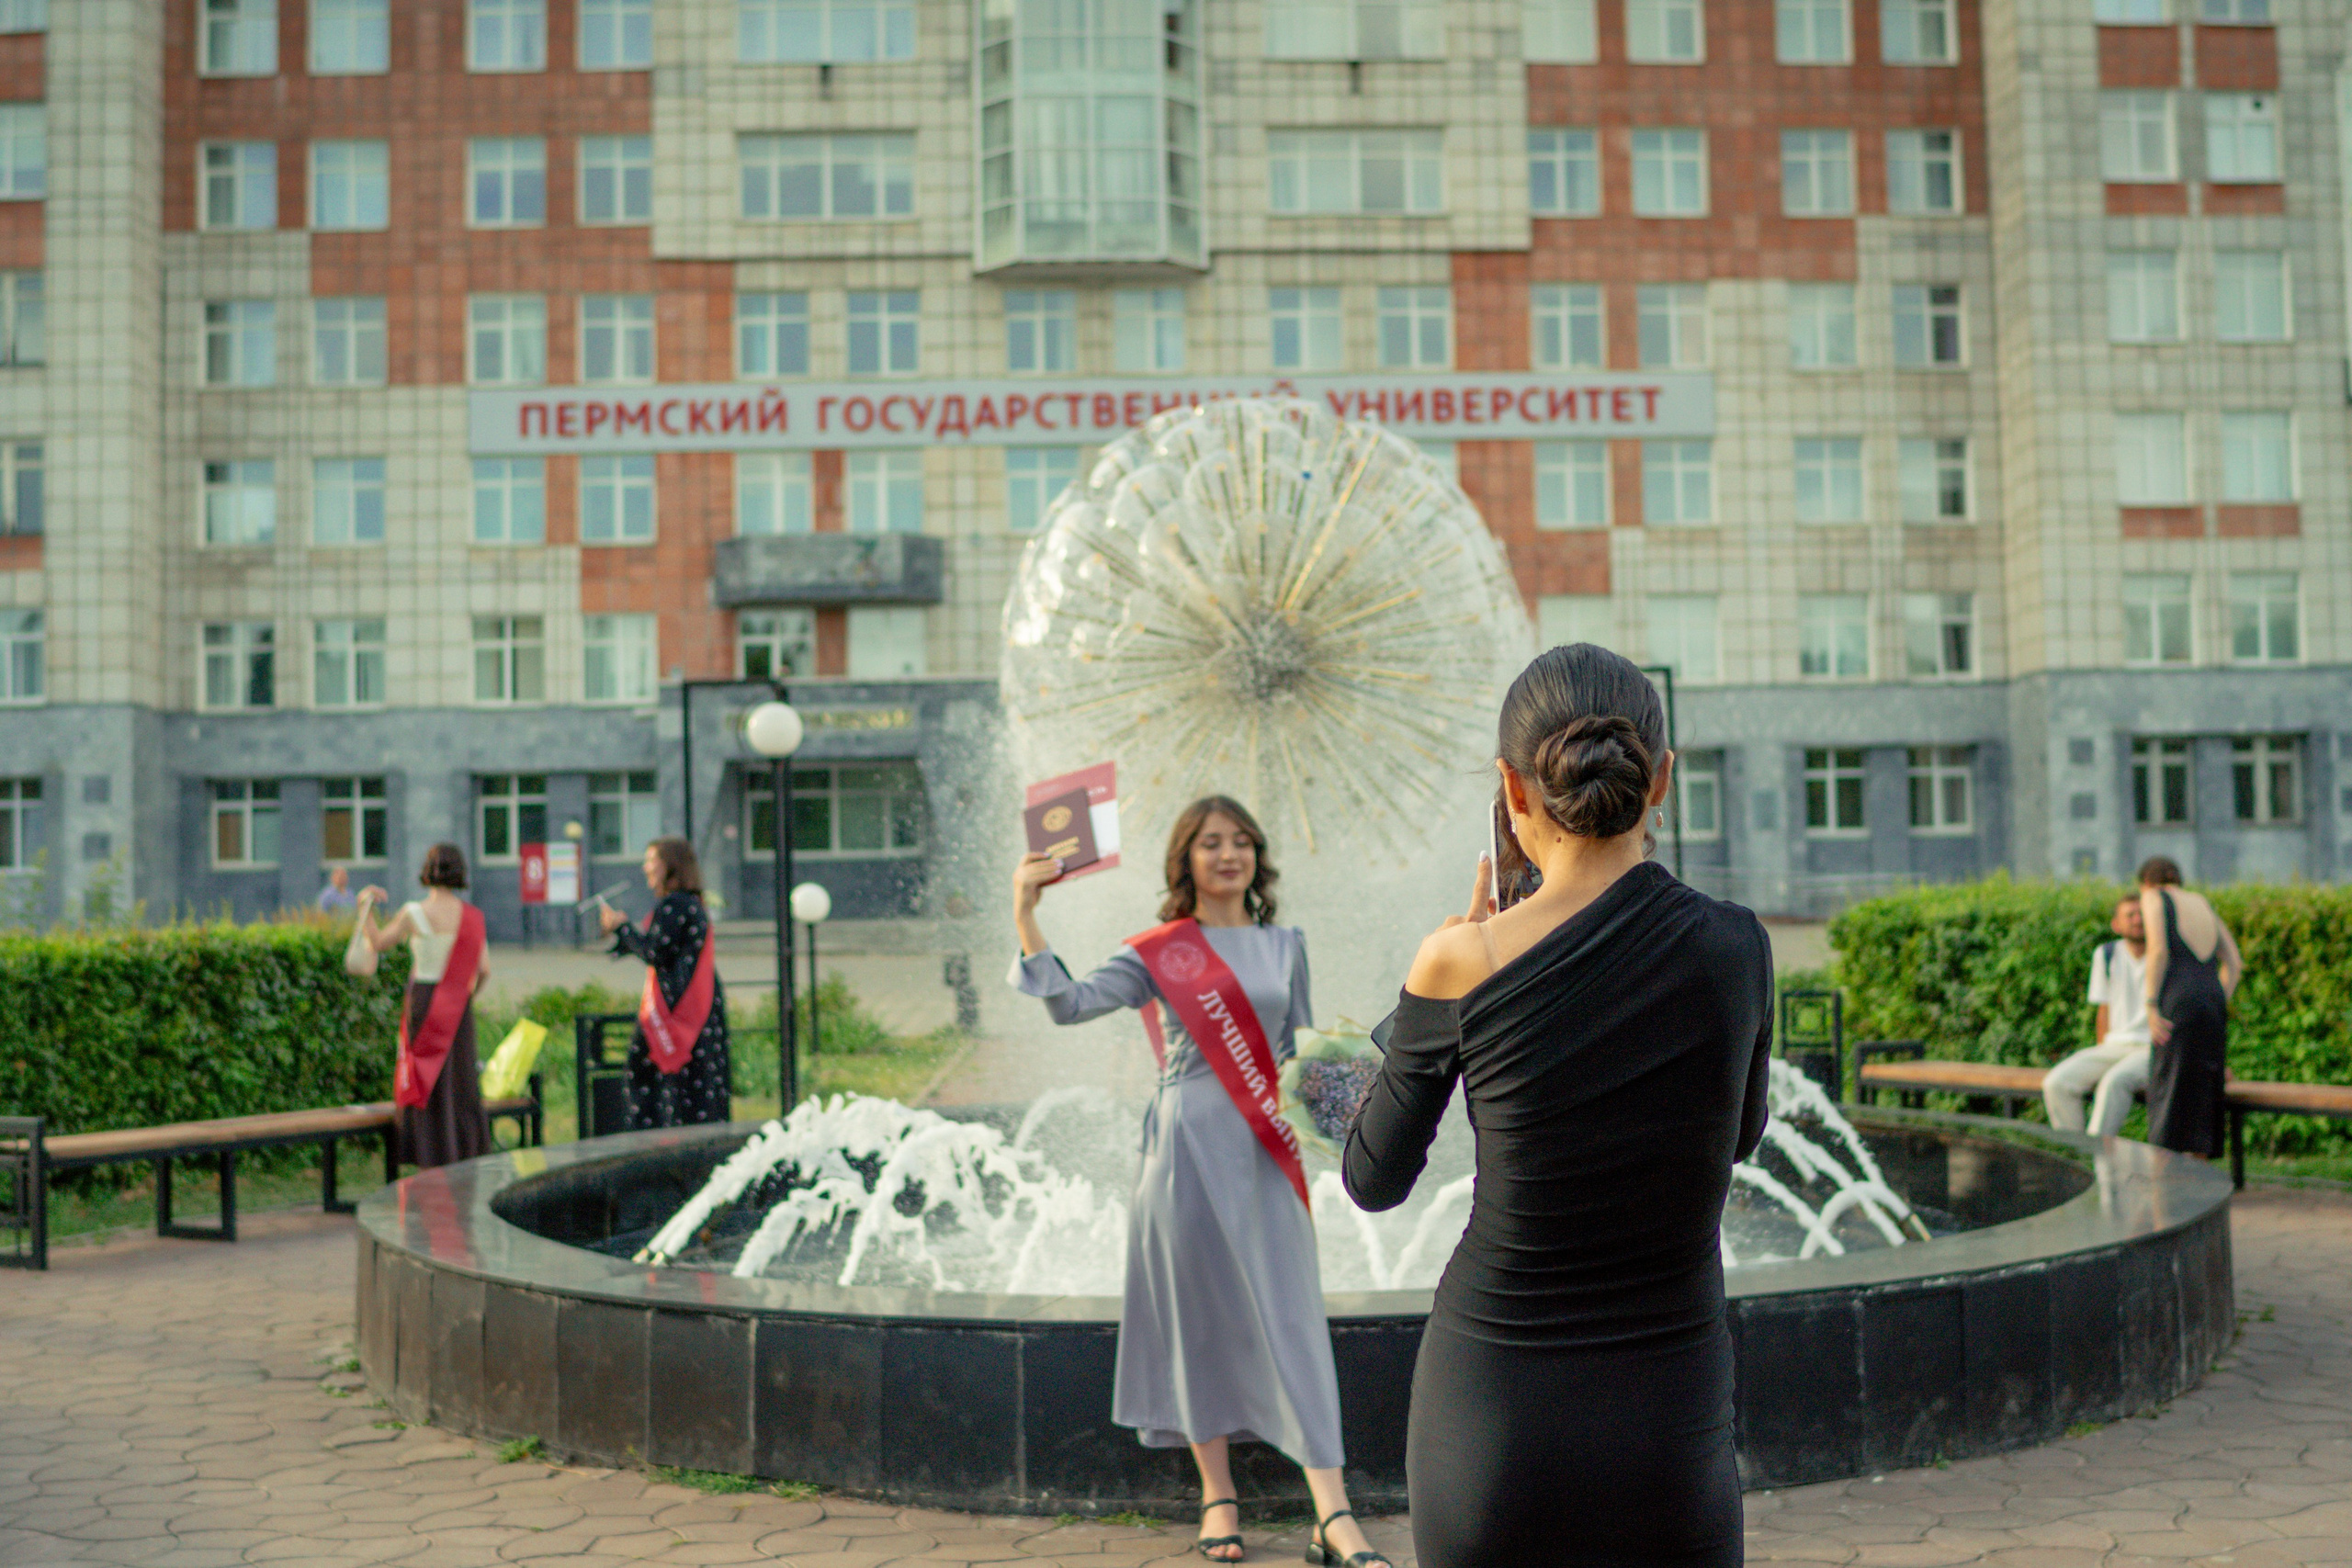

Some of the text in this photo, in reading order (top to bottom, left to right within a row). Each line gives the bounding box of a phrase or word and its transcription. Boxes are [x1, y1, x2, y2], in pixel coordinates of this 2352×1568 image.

[519, 379, 1662, 439] ПЕРМСКИЙ ГОСУДАРСТВЕН УНИВЕРСИТЕТ
[1197, 989, 1268, 1098] ЛУЧШИЙ
